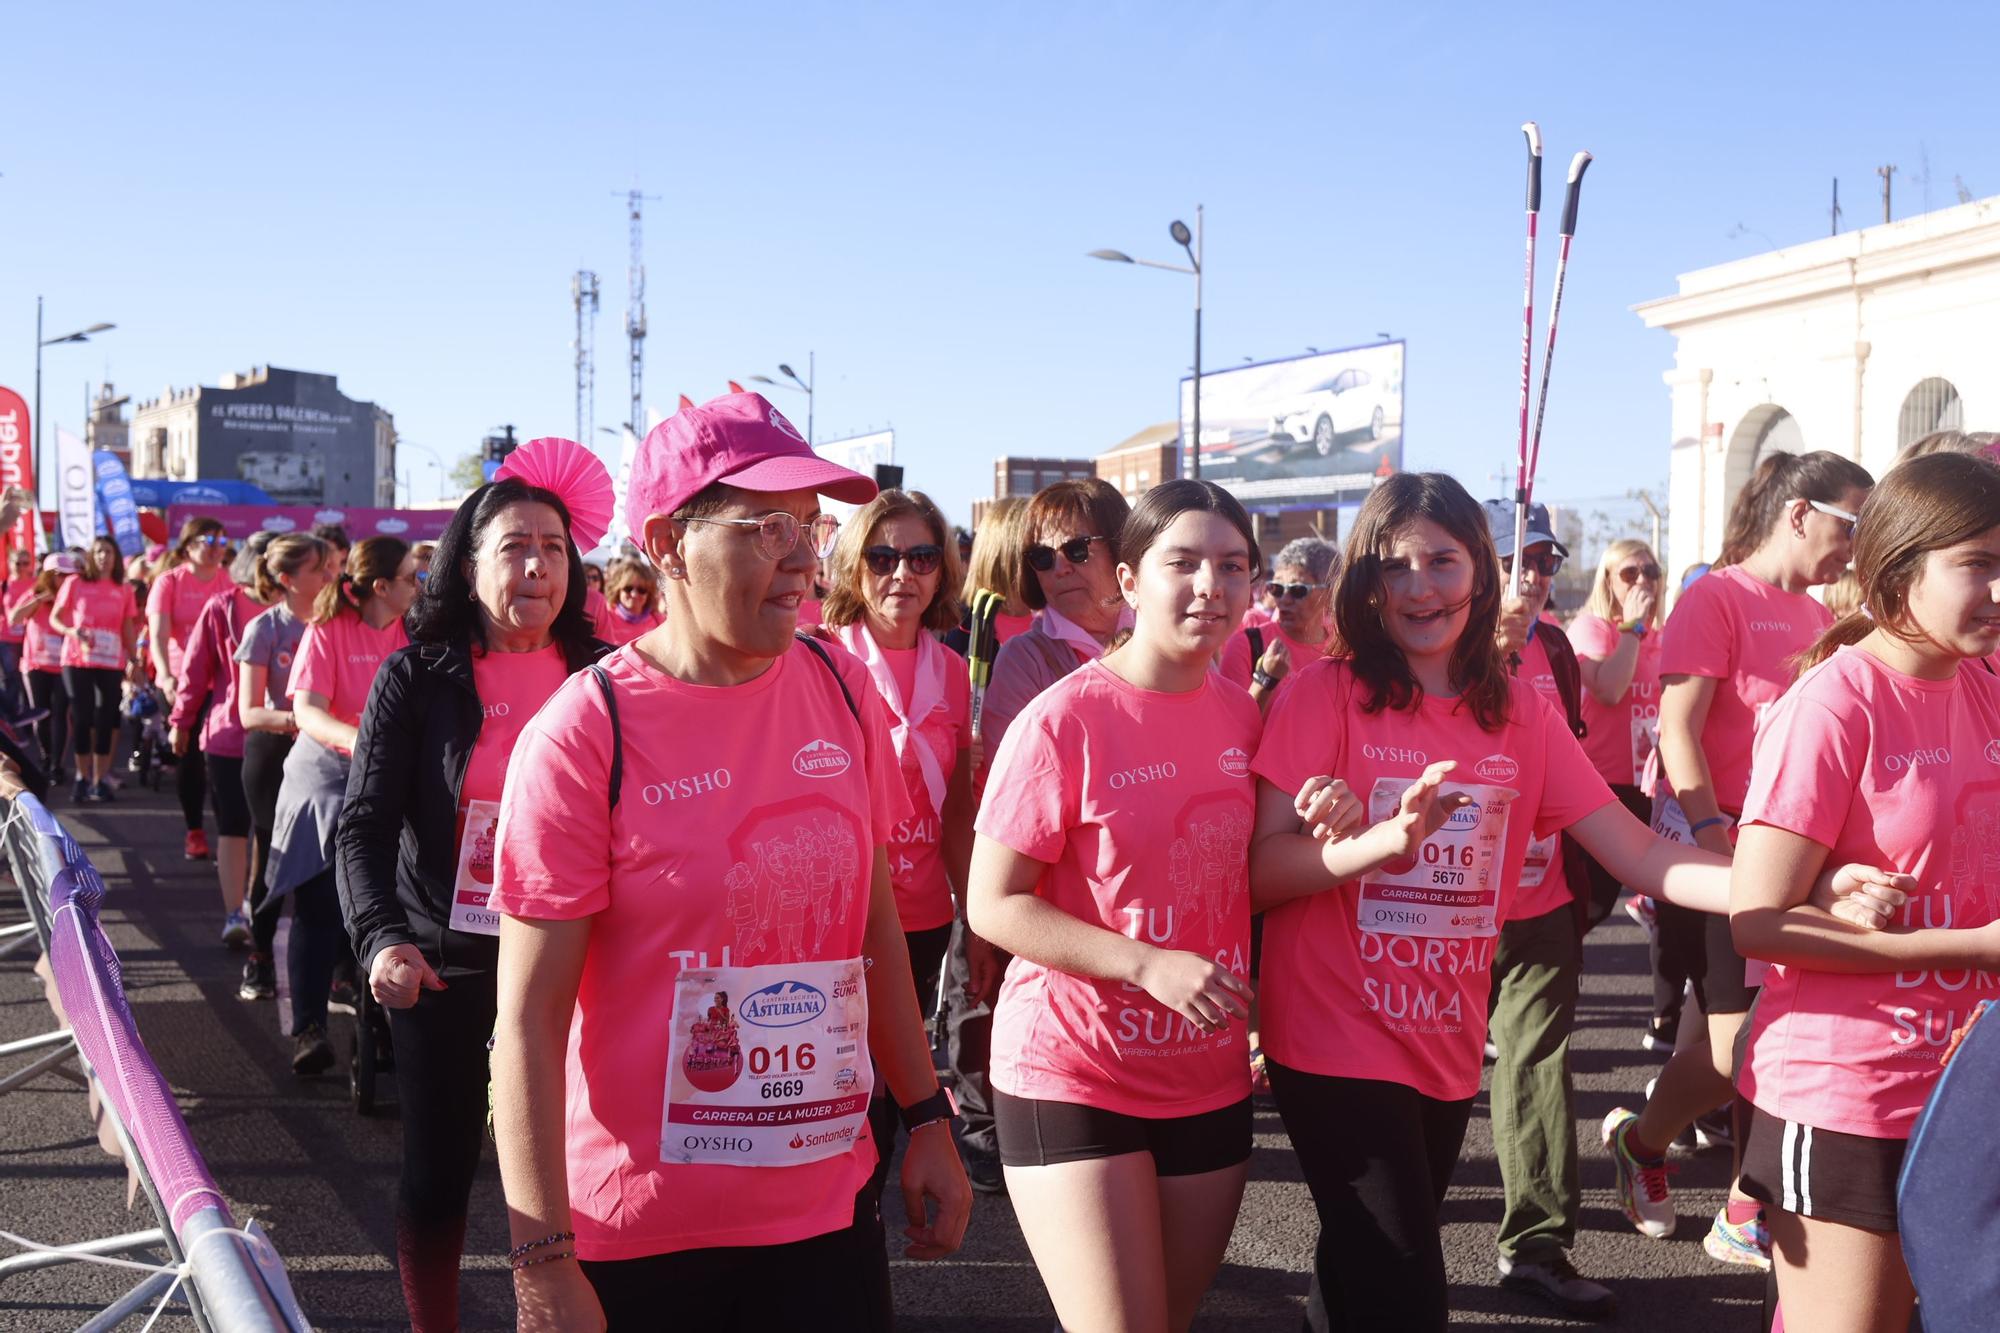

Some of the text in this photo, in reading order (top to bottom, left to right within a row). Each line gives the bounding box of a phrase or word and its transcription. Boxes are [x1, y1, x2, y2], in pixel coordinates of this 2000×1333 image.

[1751, 620, 1791, 632] OYSHO
[1632, 682, 1652, 698] TU
[1363, 743, 1427, 766] OYSHO
[1884, 747, 1951, 771] OYSHO
[1109, 761, 1176, 789] OYSHO
[642, 768, 731, 805] OYSHO
[889, 818, 936, 844] SAL
[1655, 822, 1681, 842] 016
[1424, 843, 1474, 867] 016
[1433, 871, 1464, 886] 5670
[1381, 888, 1428, 901] CARRERA
[1430, 893, 1442, 901] DE
[1444, 895, 1455, 903] LA
[466, 912, 500, 925] OYSH
[1123, 905, 1173, 943] TU
[1375, 909, 1427, 925] OYSHO
[1360, 931, 1488, 976] DORSAL
[746, 999, 820, 1018] ASTURIANA
[1360, 977, 1461, 1021] SUMA
[1116, 1008, 1228, 1045] SUM
[1889, 1007, 1969, 1045] SU
[749, 1042, 816, 1075] 016
[761, 1079, 803, 1099] 6669
[692, 1100, 855, 1122] CARRERA DE LA MUJER 2023
[683, 1135, 753, 1153] OYSHO
[805, 1126, 855, 1147] Santander
